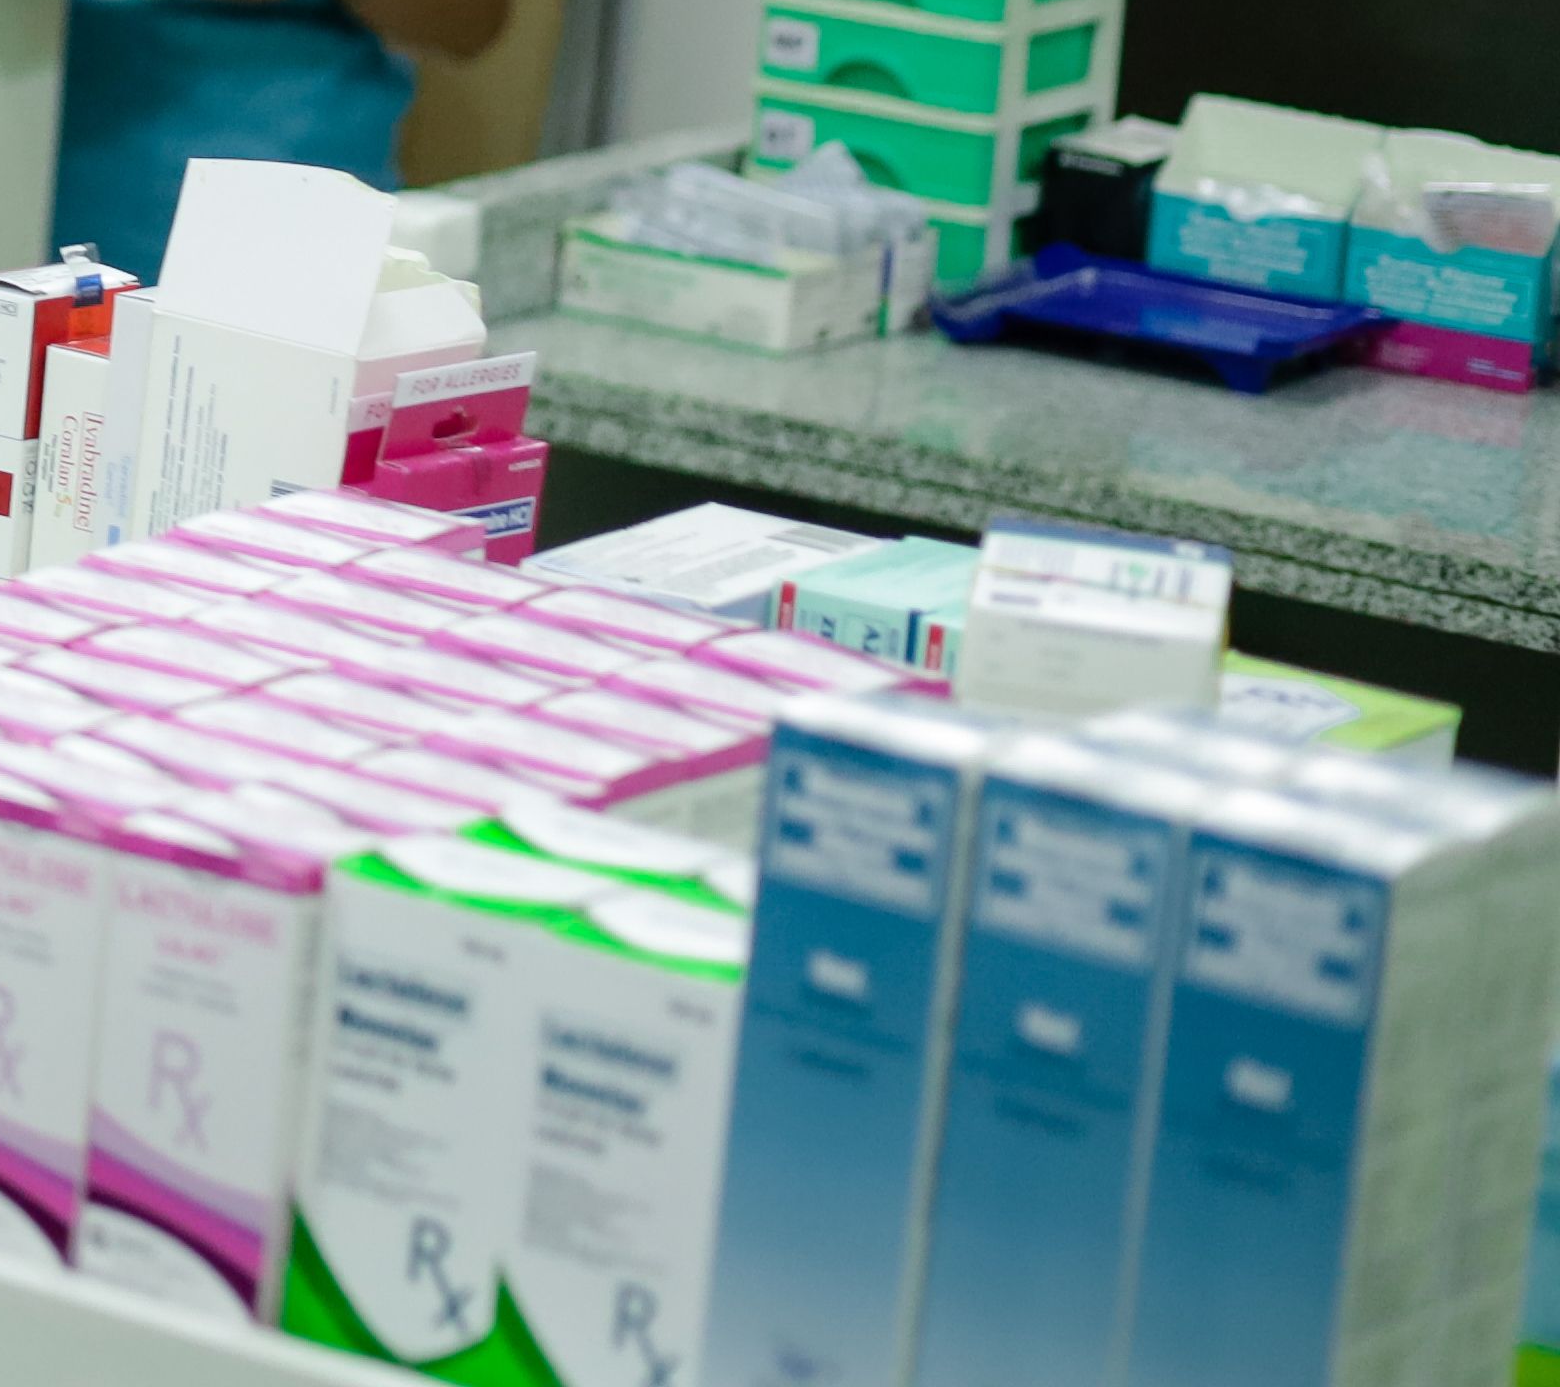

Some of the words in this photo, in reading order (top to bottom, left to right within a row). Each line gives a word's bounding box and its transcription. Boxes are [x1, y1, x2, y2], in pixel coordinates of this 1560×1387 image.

[445, 363, 524, 388] ALLERGIES
[57, 415, 77, 488] Coralan
[77, 414, 103, 532] Ivabradine
[120, 878, 275, 942] LACTULOSE
[148, 1030, 211, 1152] Rx
[408, 1216, 473, 1333] Rx
